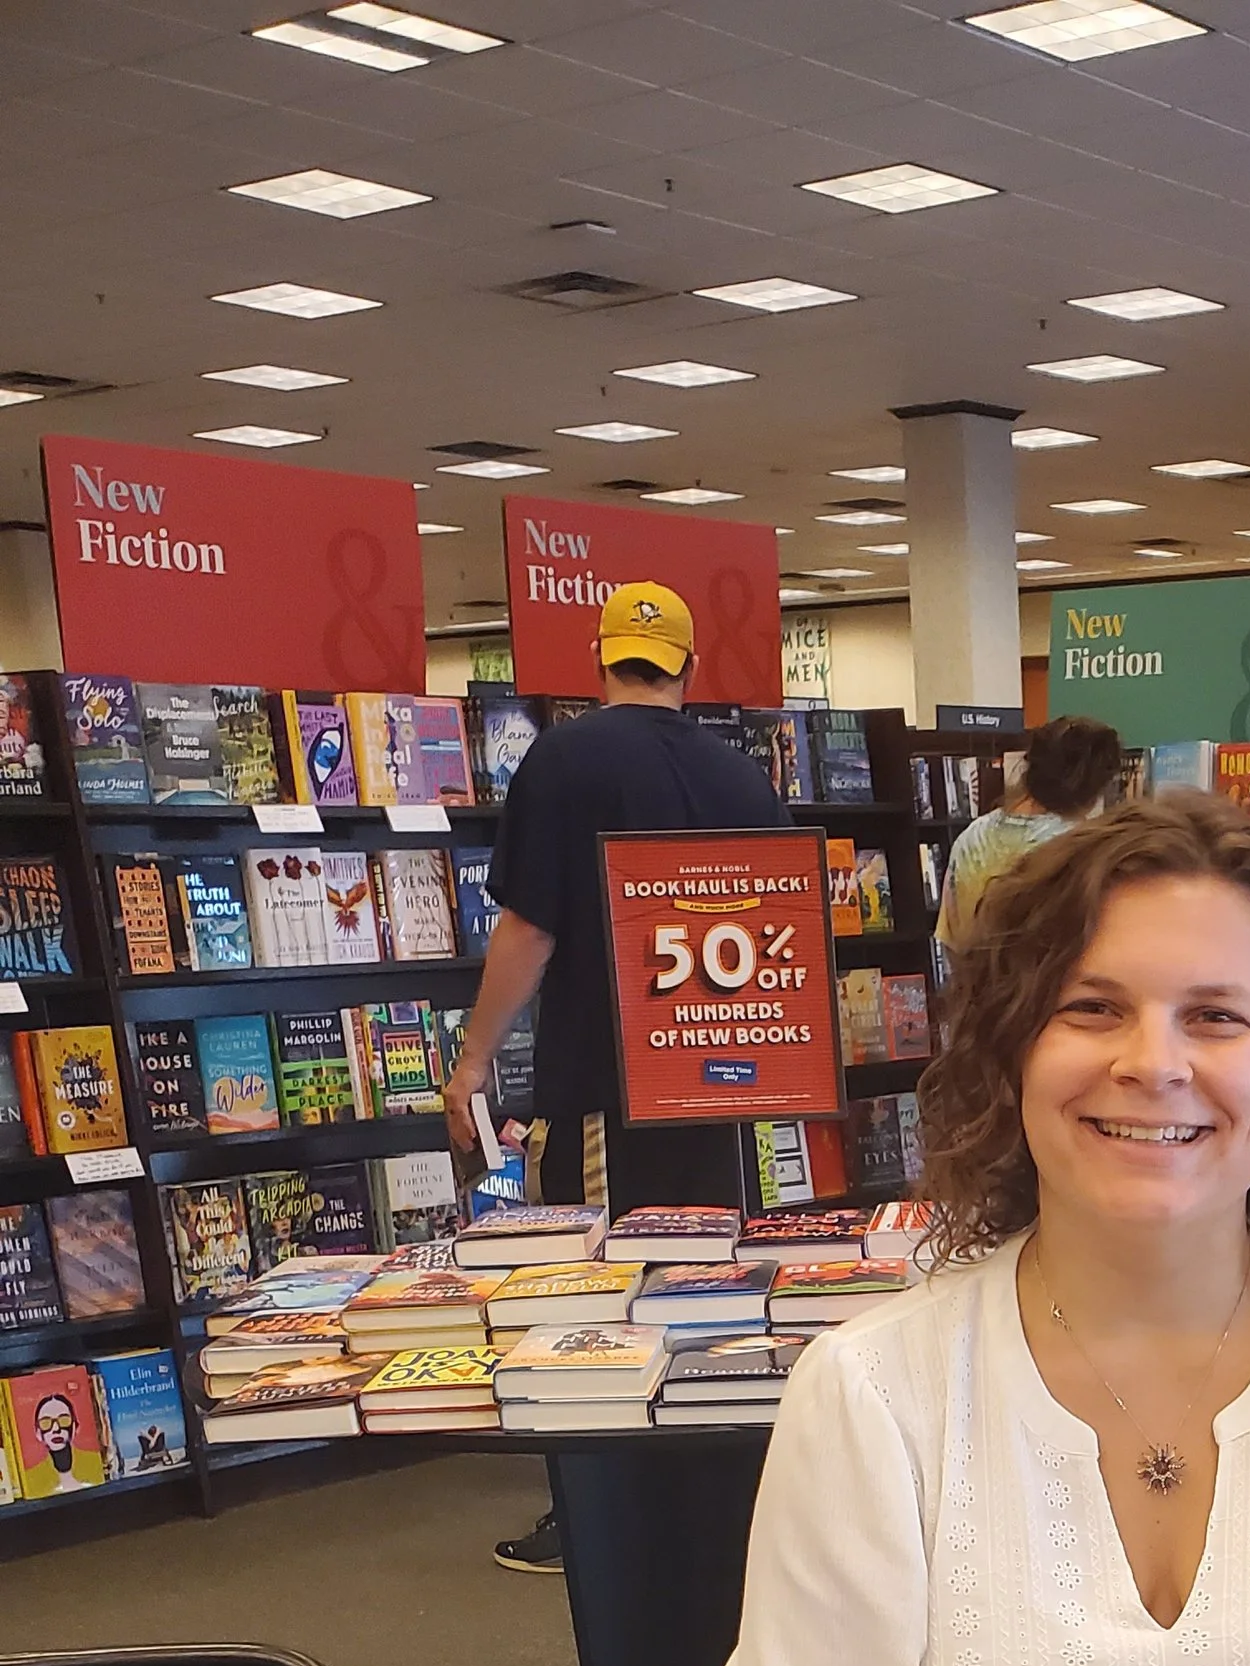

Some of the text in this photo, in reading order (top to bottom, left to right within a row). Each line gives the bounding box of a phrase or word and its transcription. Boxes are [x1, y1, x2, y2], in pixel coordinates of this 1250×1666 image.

[71, 464, 165, 515] New
[76, 518, 226, 575] Fiction
[524, 519, 591, 559] New
[1066, 609, 1127, 640] New
[783, 628, 826, 649] MICE
[795, 651, 815, 660] AND
[1064, 646, 1163, 680] Fiction
[786, 662, 825, 683] MEN
[65, 676, 128, 706] Flying
[77, 703, 124, 730] Solo
[976, 714, 1000, 727] History
[624, 877, 810, 897] BOOK HAUL IS BACK!
[197, 902, 241, 915] ABOUT
[758, 967, 807, 990] OFF
[674, 1001, 784, 1022] HUNDREDS
[290, 1020, 332, 1031] PHILLIP
[284, 1032, 341, 1046] MARGOLIN
[649, 1025, 811, 1048] OF NEW BOOKS
[72, 1066, 92, 1080] THE
[709, 1064, 752, 1074] Limited Time
[722, 1072, 739, 1081] Only
[55, 1079, 114, 1100] MEASURE
[154, 1080, 179, 1095] ON
[299, 1094, 344, 1106] PLACE
[151, 1102, 189, 1119] FIRE
[315, 1212, 365, 1233] CHANGE
[129, 1369, 151, 1381] Elin
[110, 1380, 175, 1400] Hilderbrand
